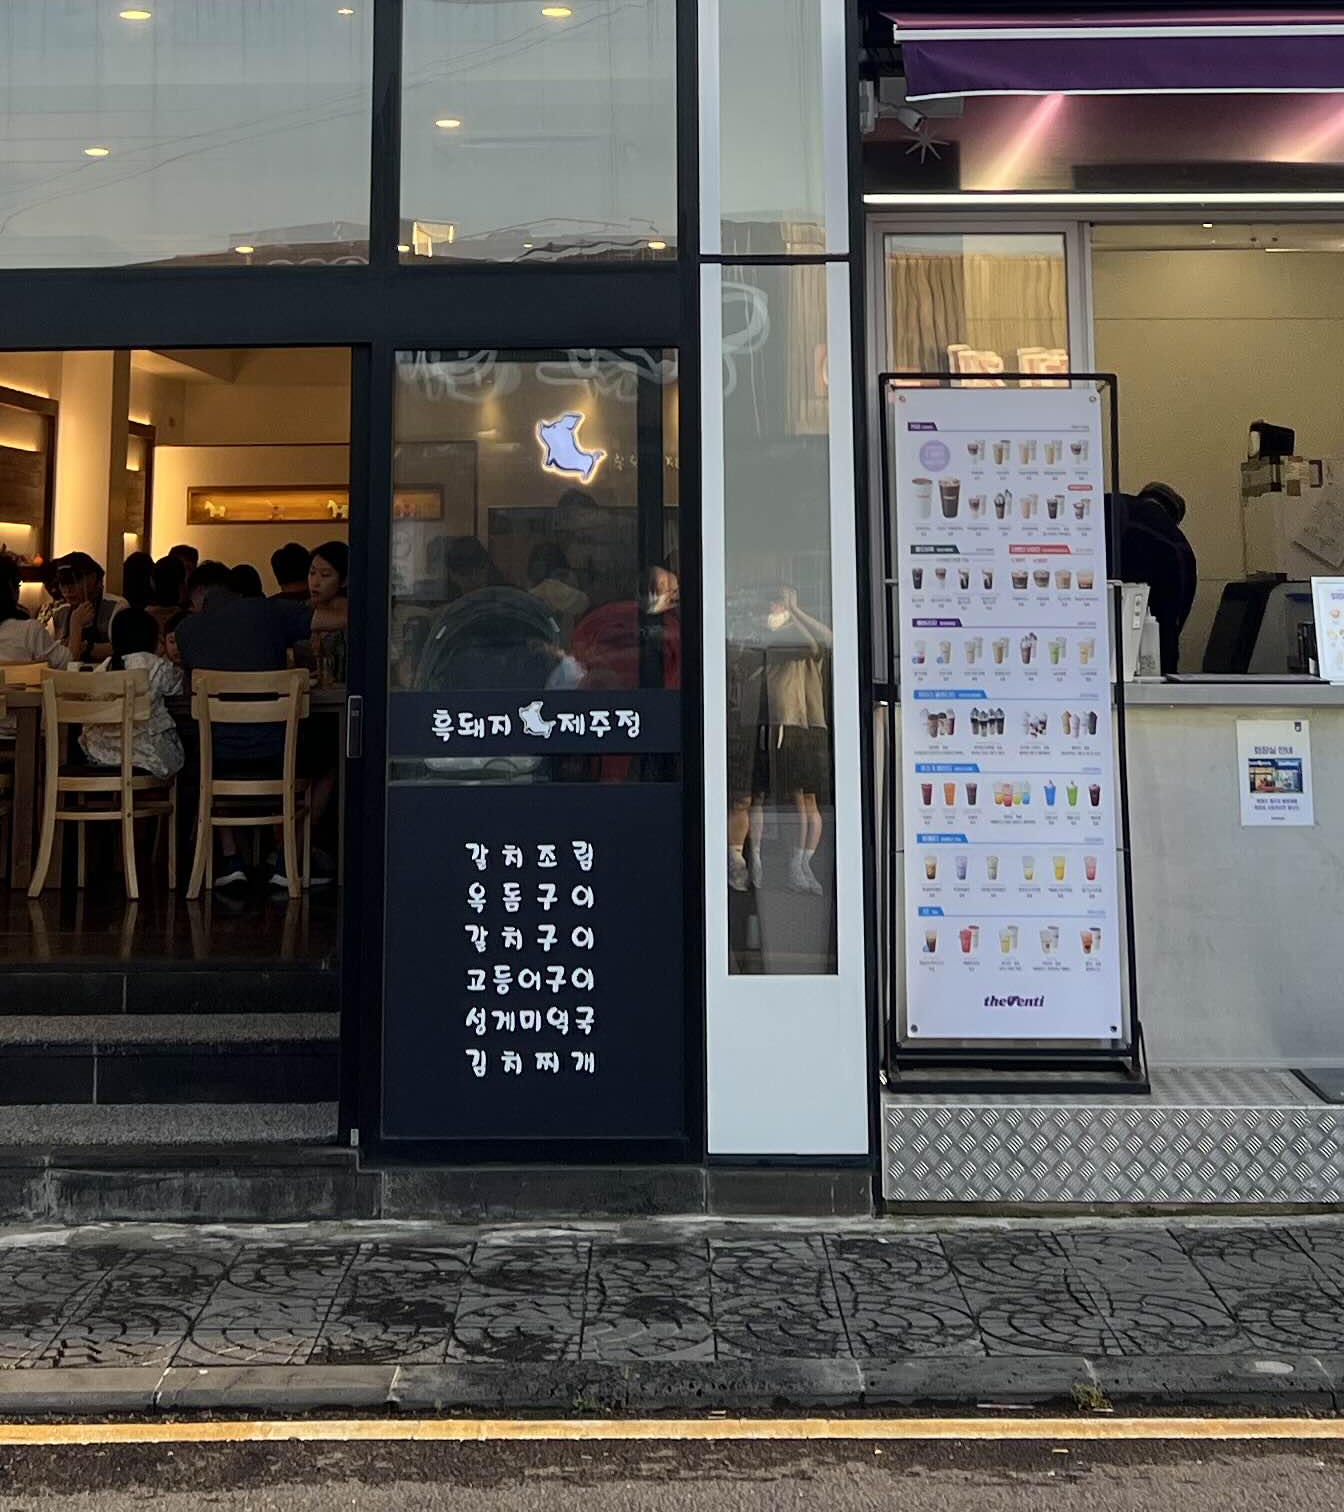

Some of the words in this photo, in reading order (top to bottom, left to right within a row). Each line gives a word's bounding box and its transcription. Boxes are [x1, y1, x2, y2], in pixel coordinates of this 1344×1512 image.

[432, 709, 511, 742] 흑돼지
[556, 709, 640, 738] 제주정
[465, 840, 594, 871] 갈치조림
[467, 882, 594, 914] 옥돔구이
[464, 924, 594, 953] 갈치구이
[466, 964, 595, 995] 고등어구이
[465, 1006, 595, 1036] 성게미역국
[465, 1048, 595, 1078] 김치찌개
